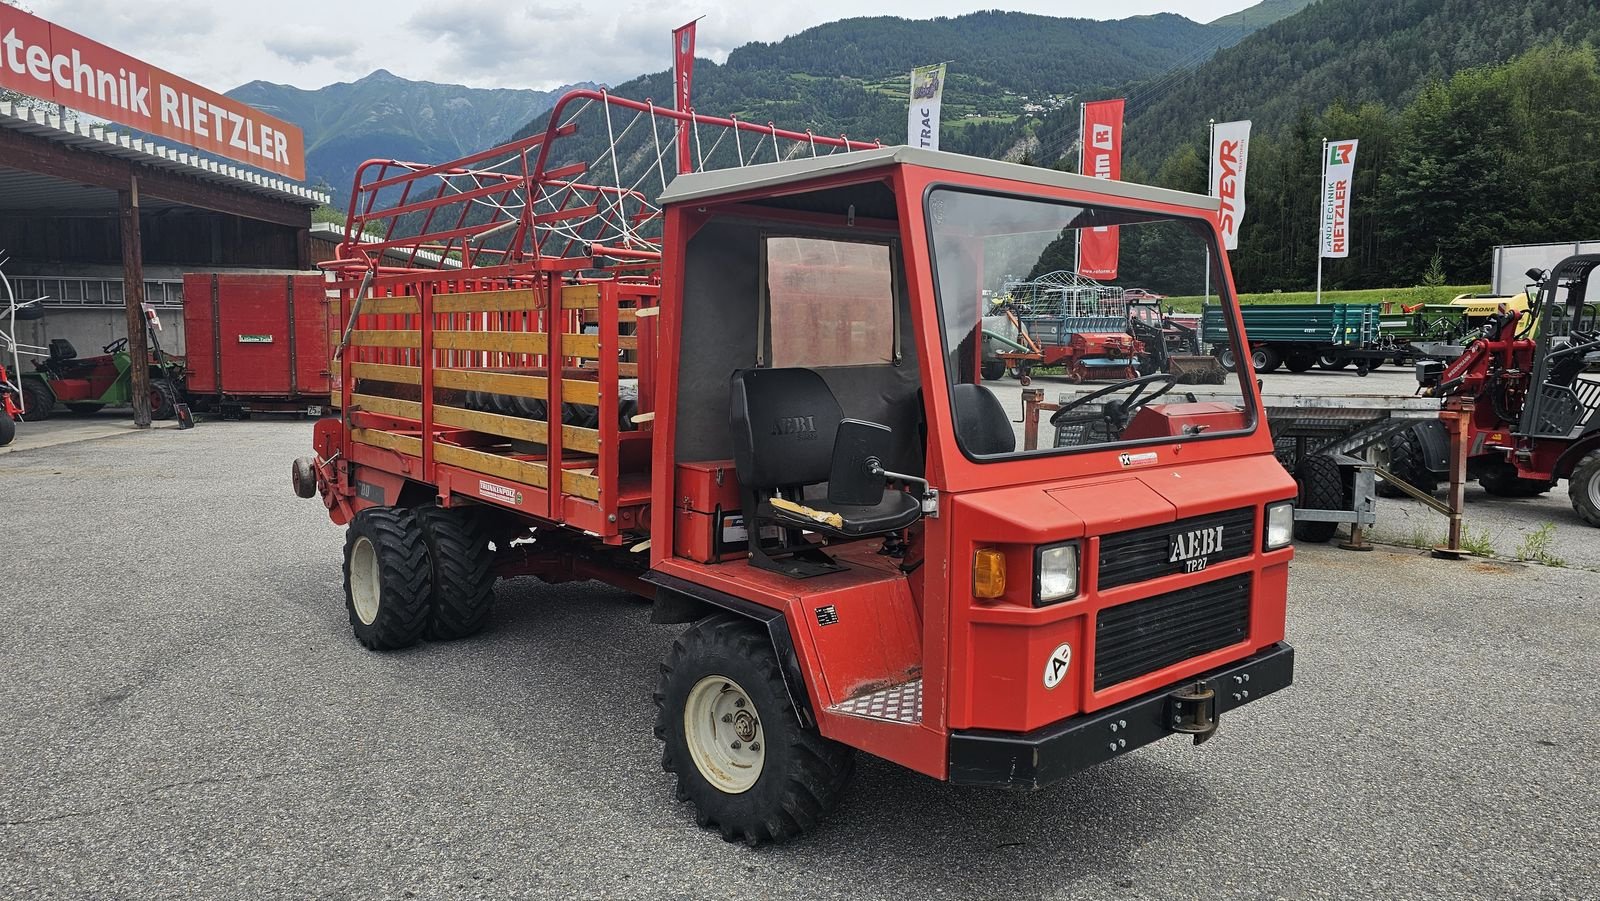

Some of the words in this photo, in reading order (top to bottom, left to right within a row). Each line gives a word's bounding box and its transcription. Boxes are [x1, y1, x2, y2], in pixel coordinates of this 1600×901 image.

[0, 27, 151, 118] technik
[159, 83, 290, 166] RIETZLER
[1219, 140, 1238, 236] STEYR
[1325, 182, 1335, 253] LANDTECHNIK
[1332, 179, 1347, 253] RIETZLER
[1169, 526, 1224, 562] AEBI
